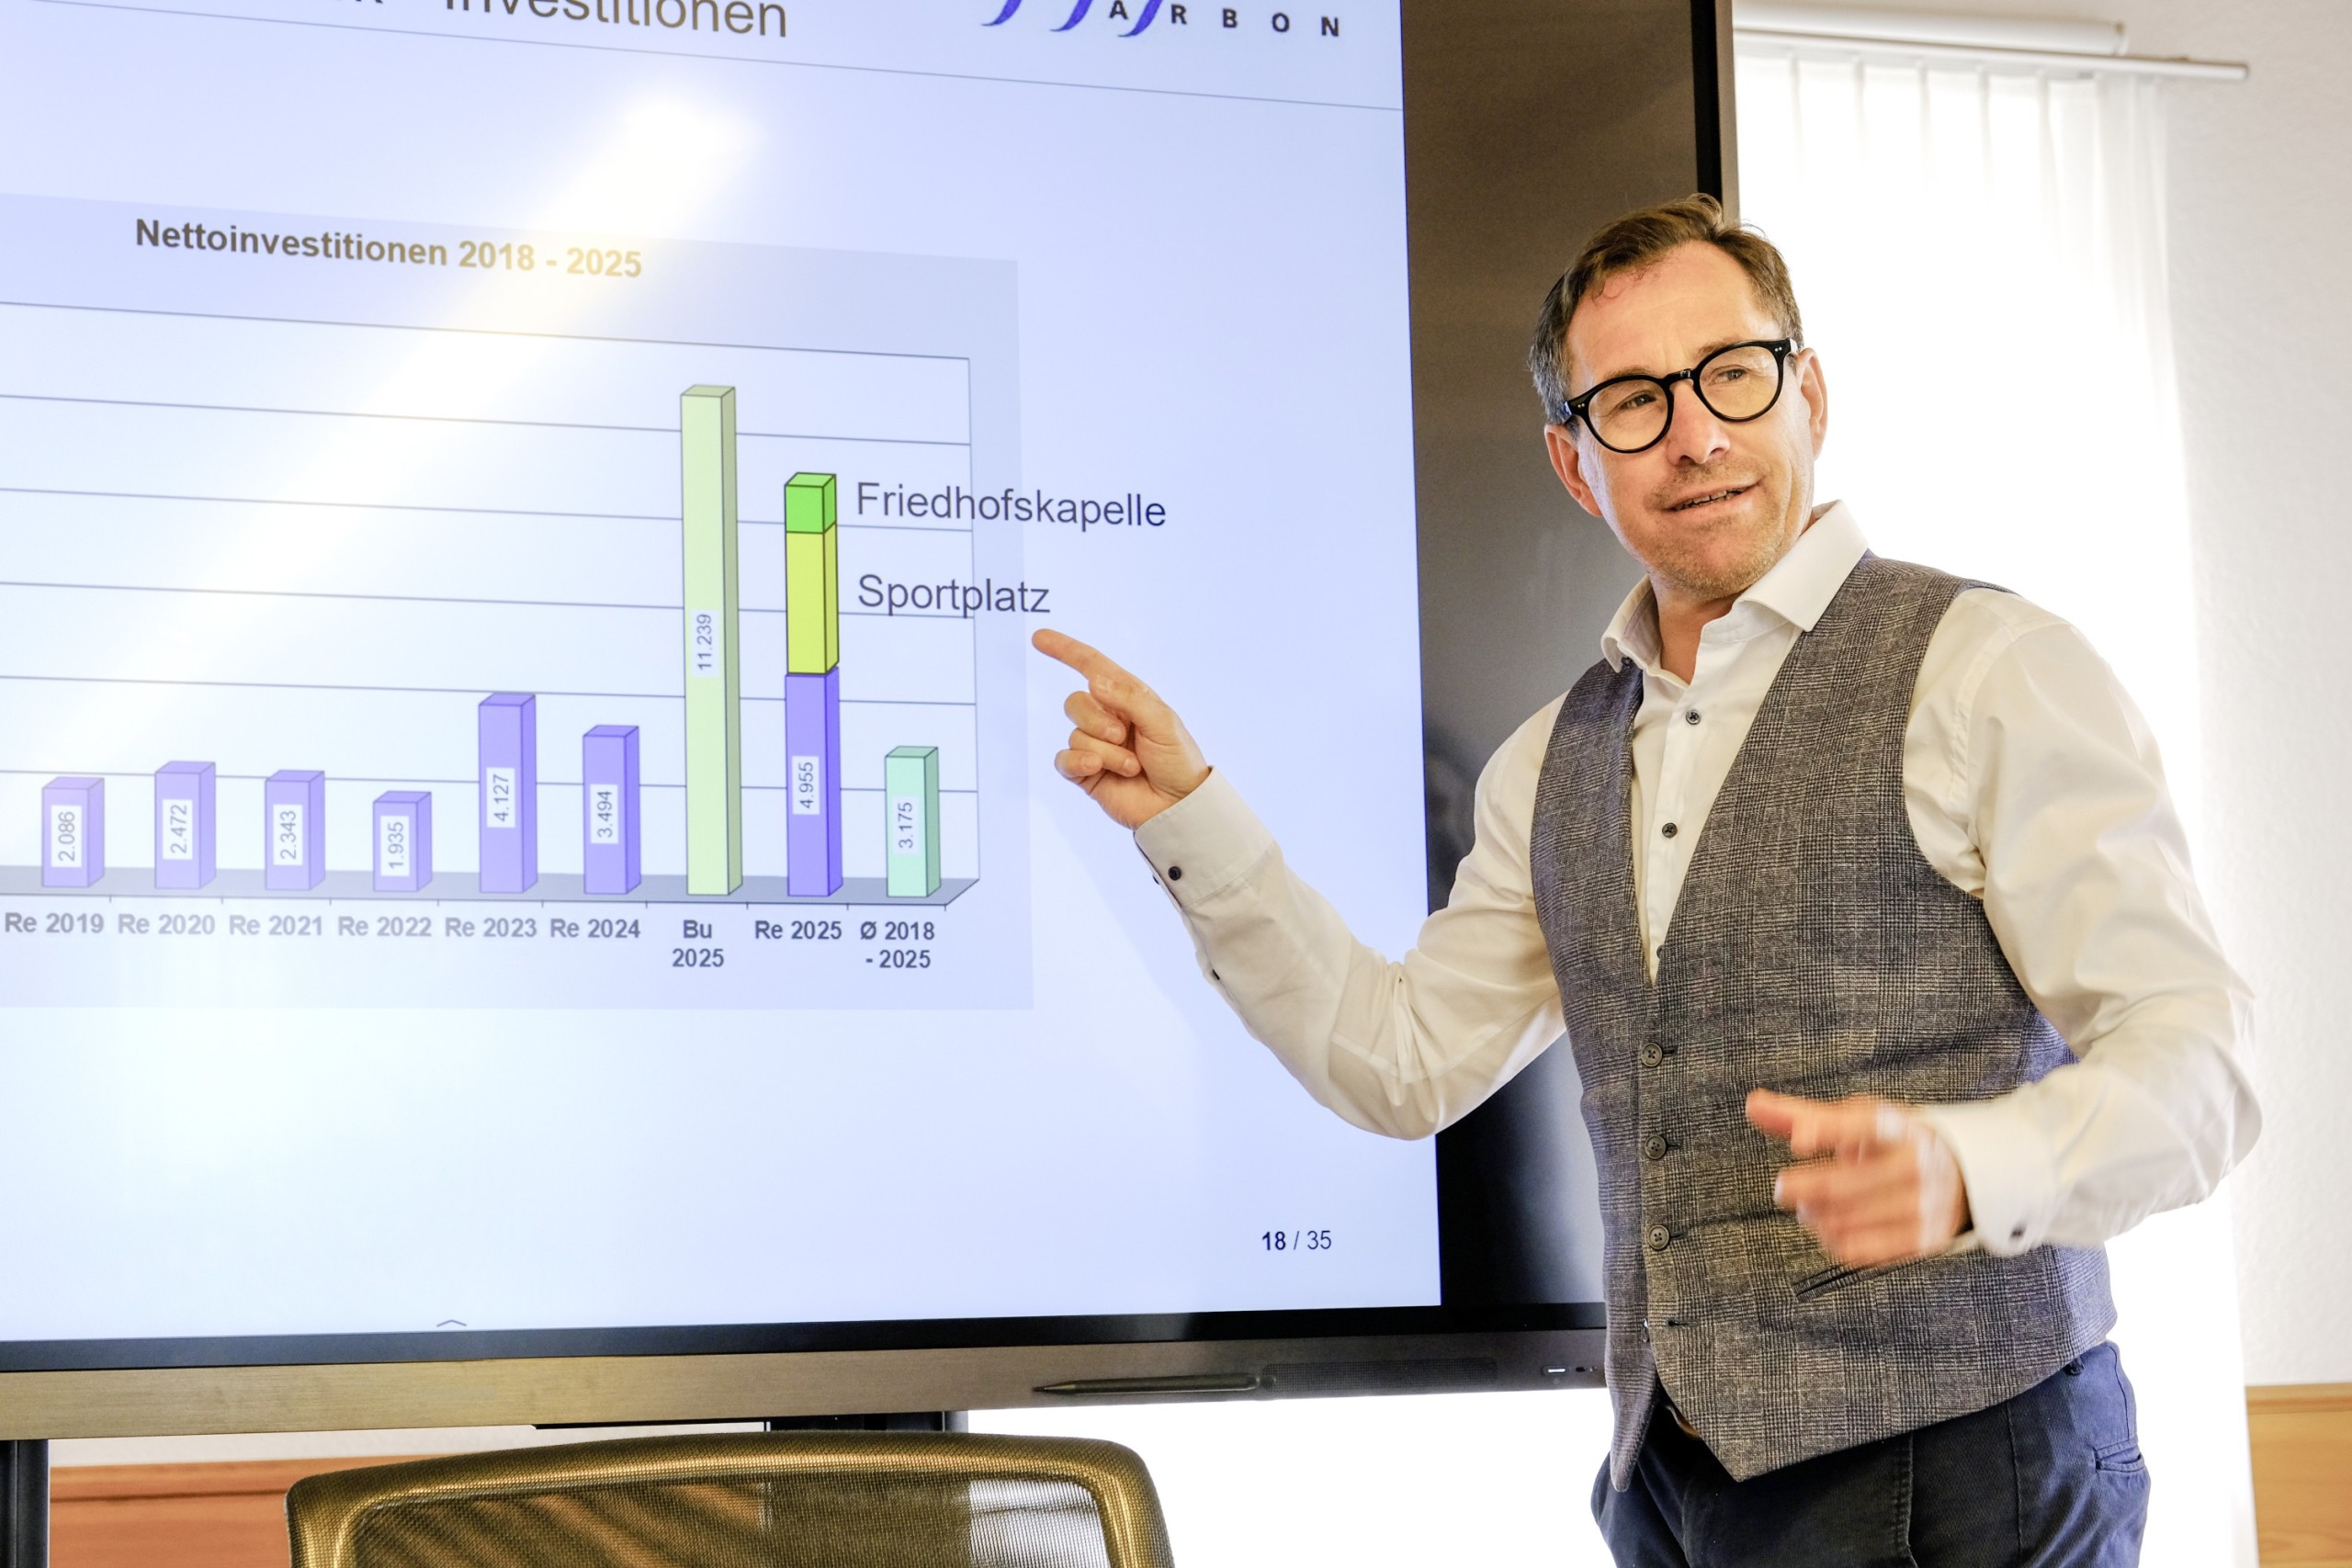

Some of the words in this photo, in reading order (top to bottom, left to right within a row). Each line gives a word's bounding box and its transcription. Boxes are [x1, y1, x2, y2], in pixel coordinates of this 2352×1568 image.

[446, 0, 786, 38] estitionen
[1108, 0, 1340, 38] ARBON
[136, 218, 447, 265] Nettoinvestitionen
[458, 239, 534, 270] 2018
[566, 247, 643, 279] 2025
[856, 481, 1167, 533] Friedhofskapelle
[857, 573, 1051, 619] Sportplatz
[695, 614, 713, 671] 11.239
[492, 773, 509, 822] 4.127
[797, 761, 814, 809] 4.955
[169, 804, 187, 854] 2.472
[596, 791, 613, 838] 3.494
[897, 802, 913, 849] 3.175
[57, 811, 75, 863] 2.086
[279, 810, 297, 861] 2.343
[387, 821, 404, 869] 1.935
[5, 911, 38, 933] Re
[45, 912, 105, 934] 2019
[118, 913, 151, 935] Re
[158, 913, 216, 935] 2020
[229, 914, 261, 936] Re
[268, 915, 322, 937] 2021
[337, 915, 369, 937] Re
[377, 916, 432, 938] 2022
[445, 917, 476, 938] Re
[483, 917, 537, 938] 2023
[549, 918, 580, 939] Re
[587, 919, 641, 939] 2024
[683, 919, 713, 940] Bu
[754, 919, 784, 940] Re
[790, 919, 842, 941] 2025
[860, 920, 877, 941] Ø
[885, 920, 935, 941] 2018
[672, 948, 725, 968] 2025
[879, 949, 932, 969] 2025
[1261, 1231, 1286, 1251] 18
[1293, 1230, 1300, 1251] /
[1307, 1230, 1332, 1250] 35
